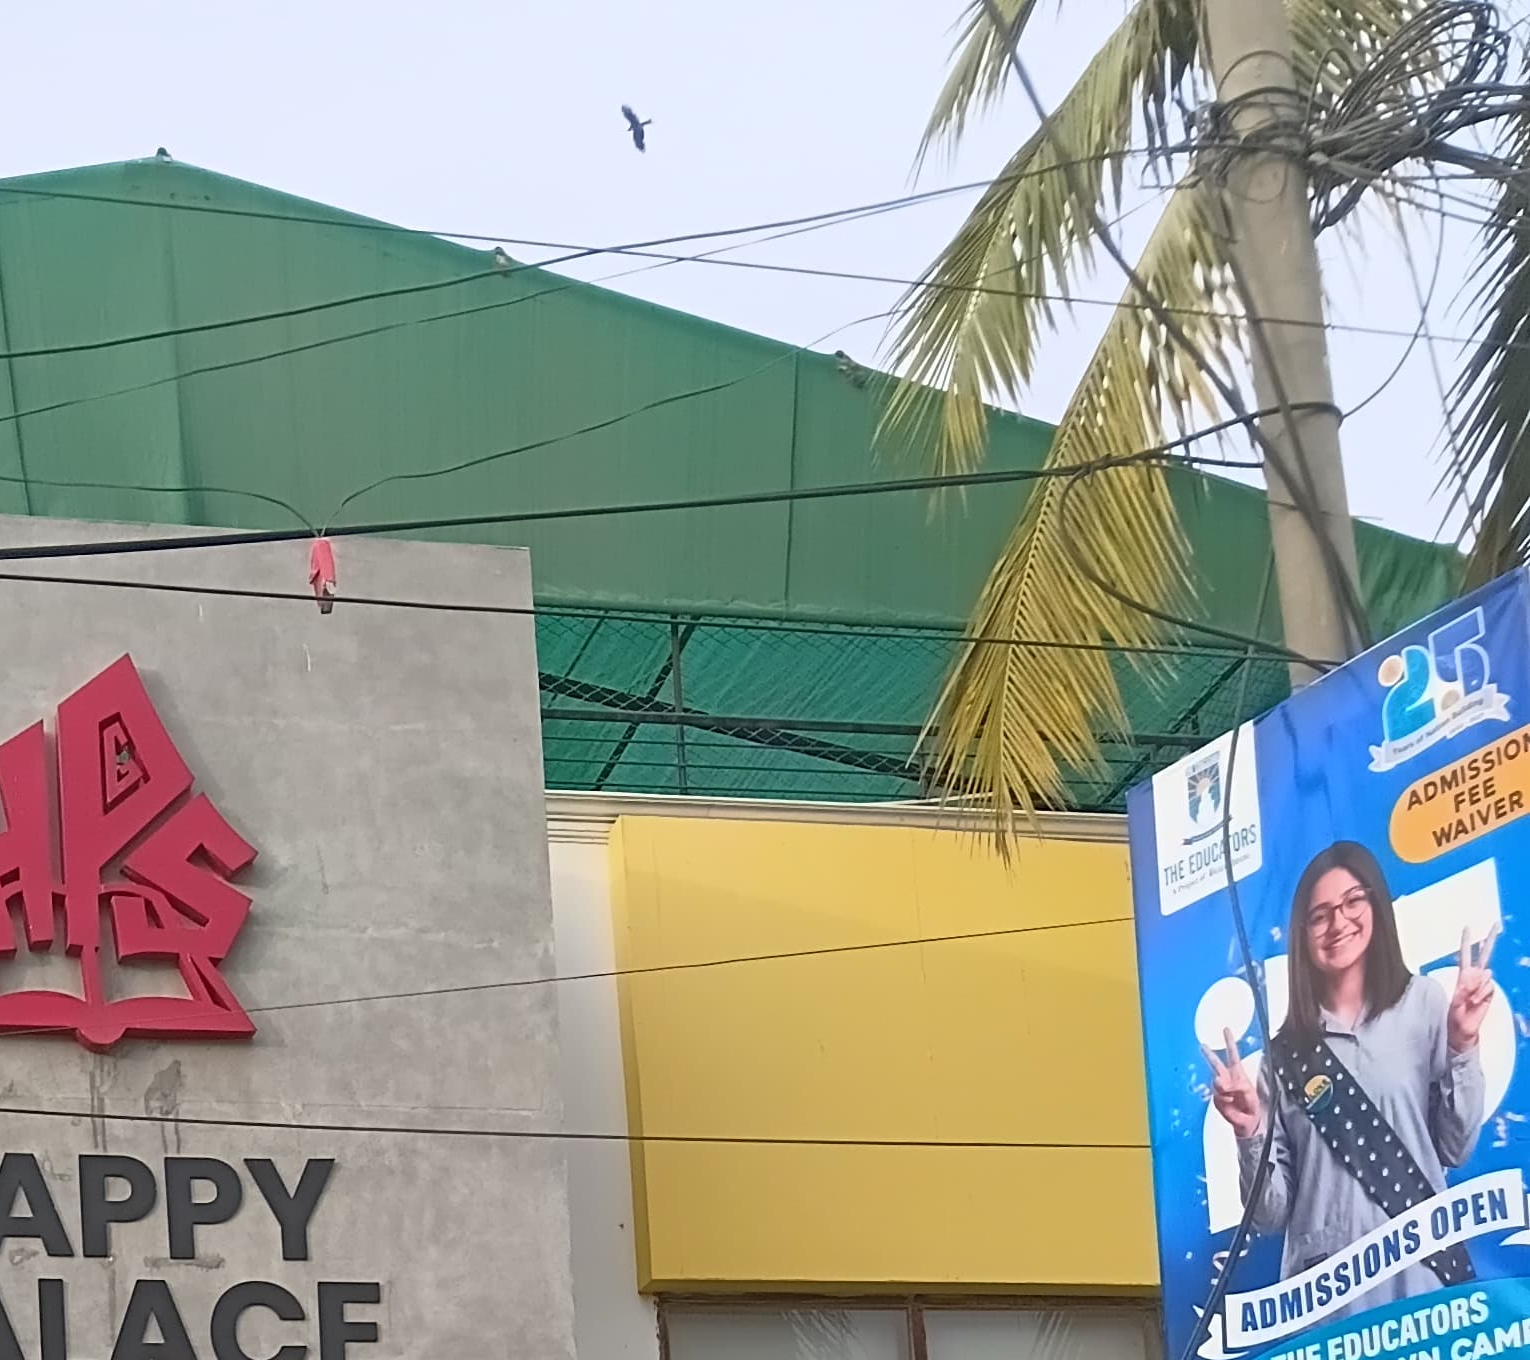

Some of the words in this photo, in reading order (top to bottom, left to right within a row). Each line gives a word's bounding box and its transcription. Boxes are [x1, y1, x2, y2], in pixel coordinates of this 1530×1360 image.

[1453, 776, 1497, 813] FEE
[1432, 790, 1524, 847] WAIVER
[1164, 860, 1185, 886] THE
[1241, 1219, 1421, 1332] ADMISSIONS
[1430, 1187, 1508, 1241] OPEN
